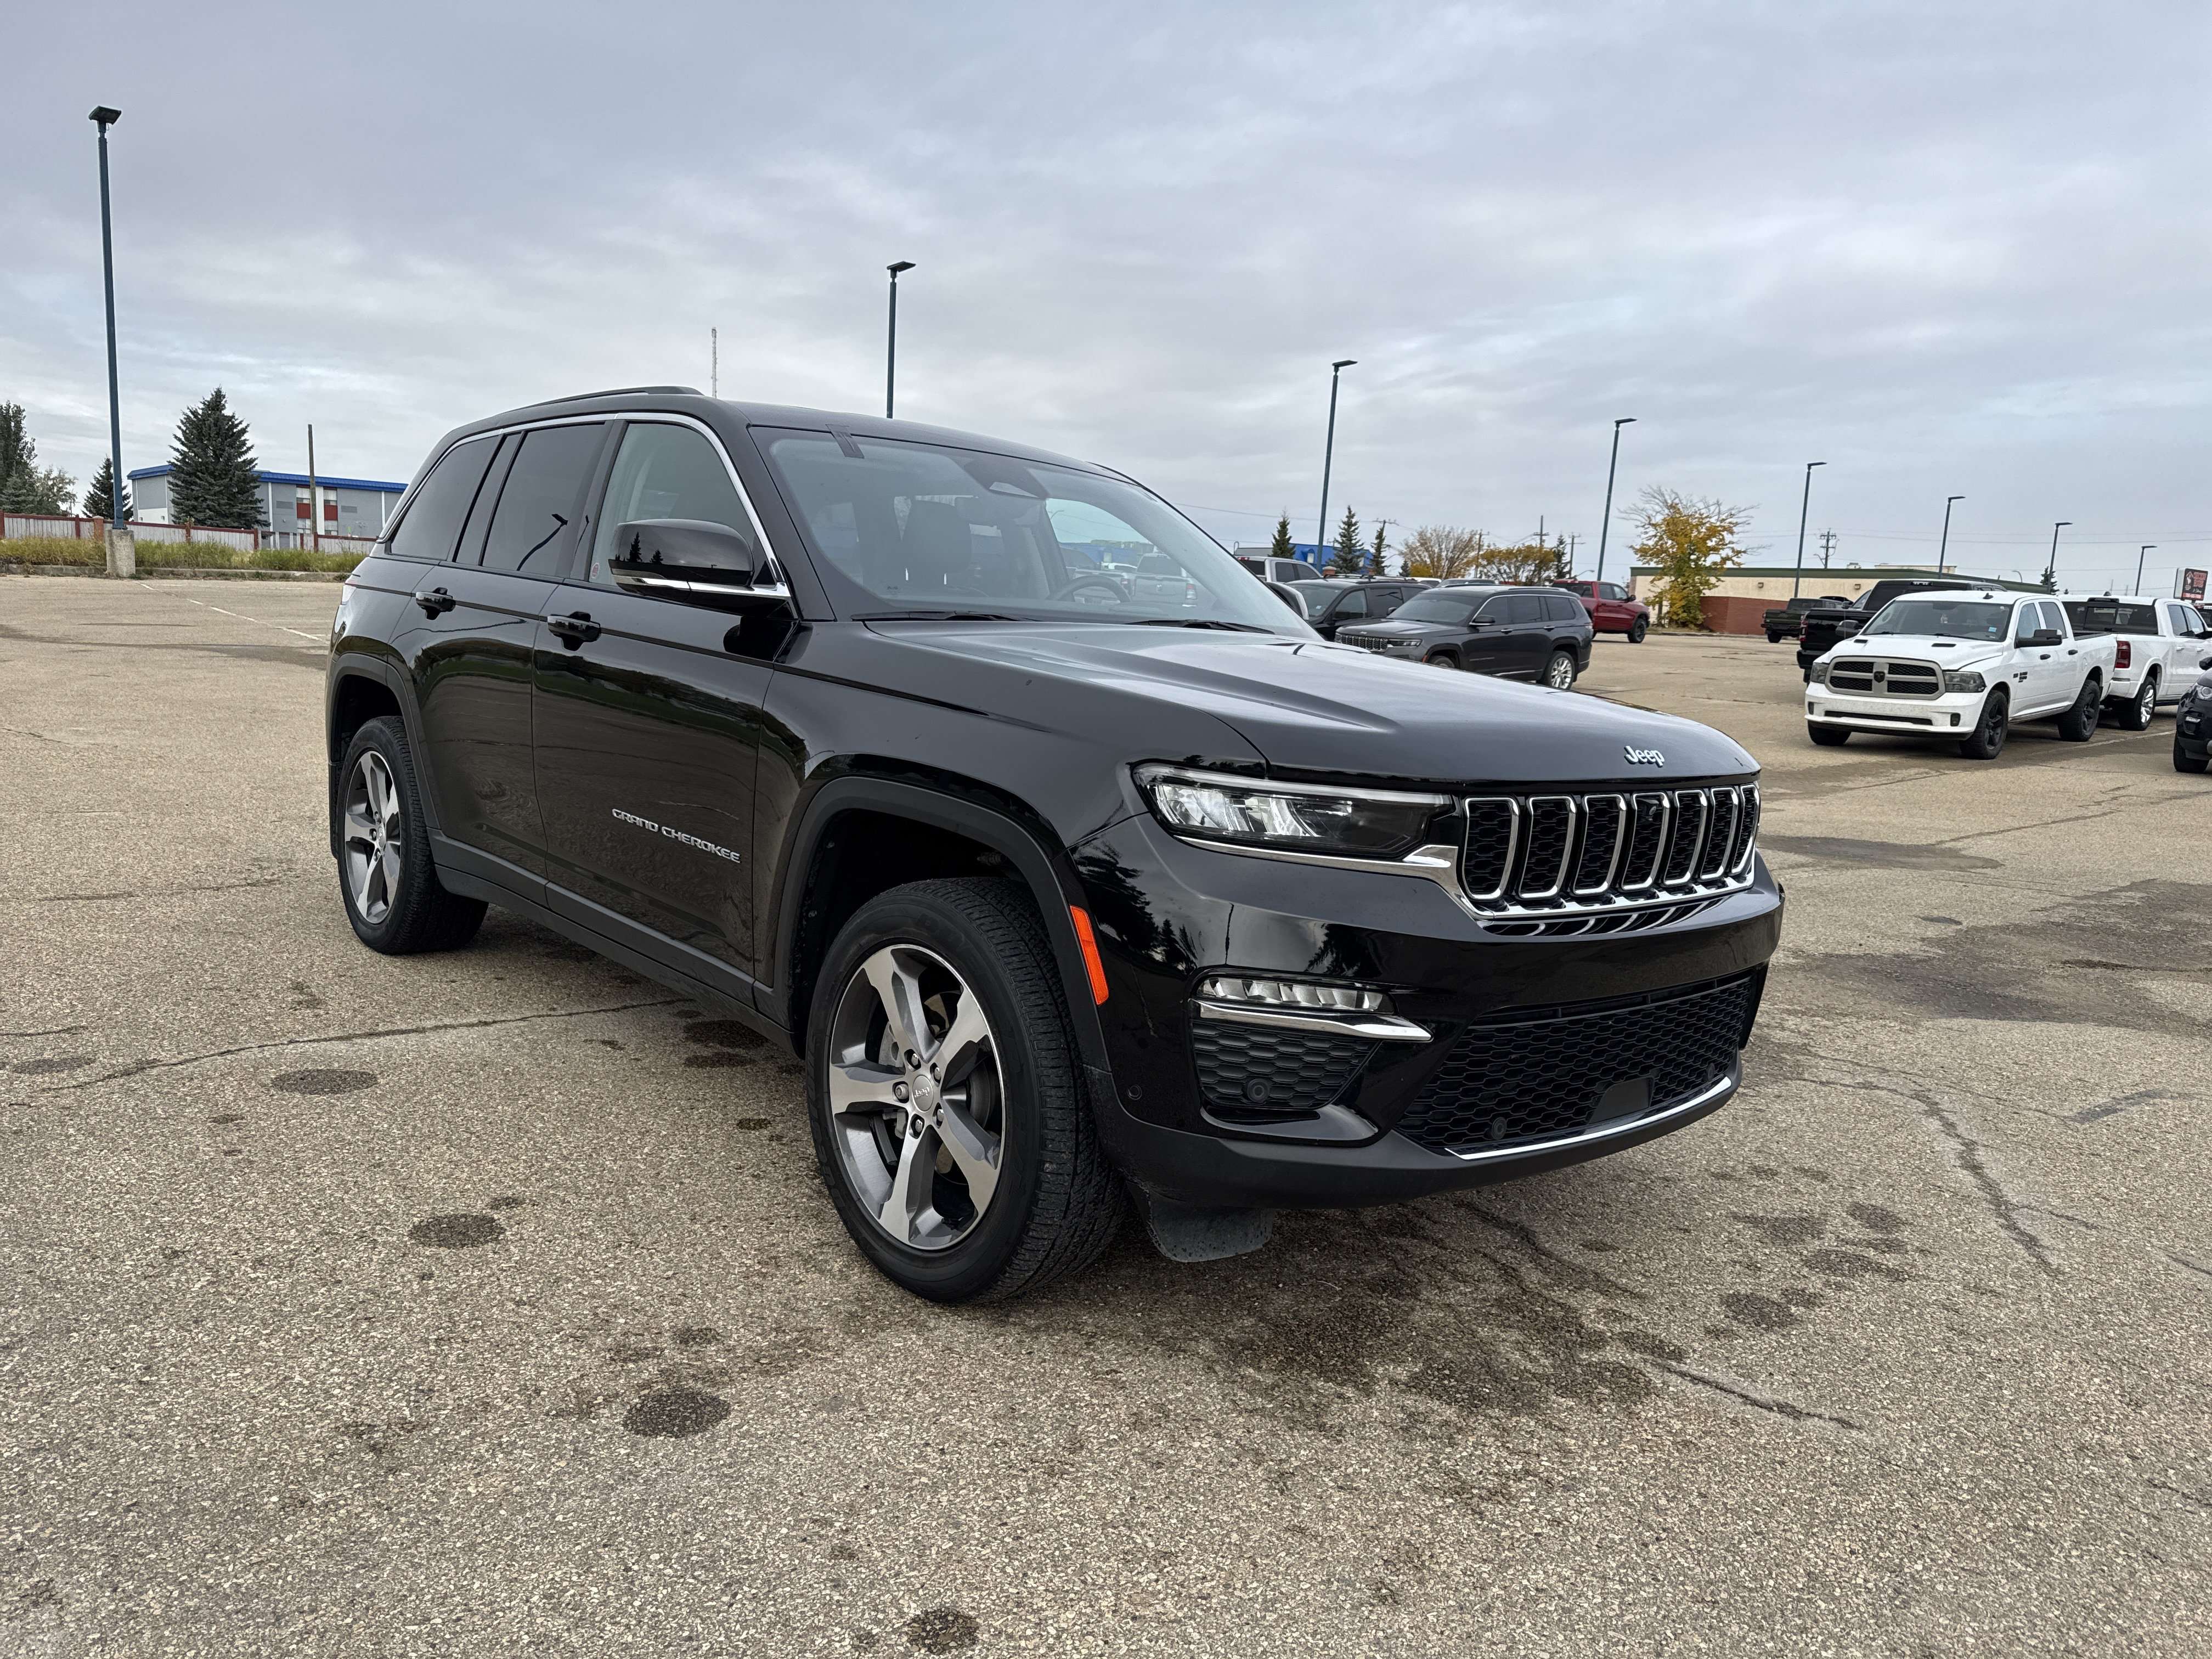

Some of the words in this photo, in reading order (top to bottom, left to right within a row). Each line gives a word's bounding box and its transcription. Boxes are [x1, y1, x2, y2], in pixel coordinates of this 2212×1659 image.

[1624, 746, 1665, 768] Jeep
[612, 808, 659, 833] GRAND
[661, 826, 741, 864] CHEROKEE
